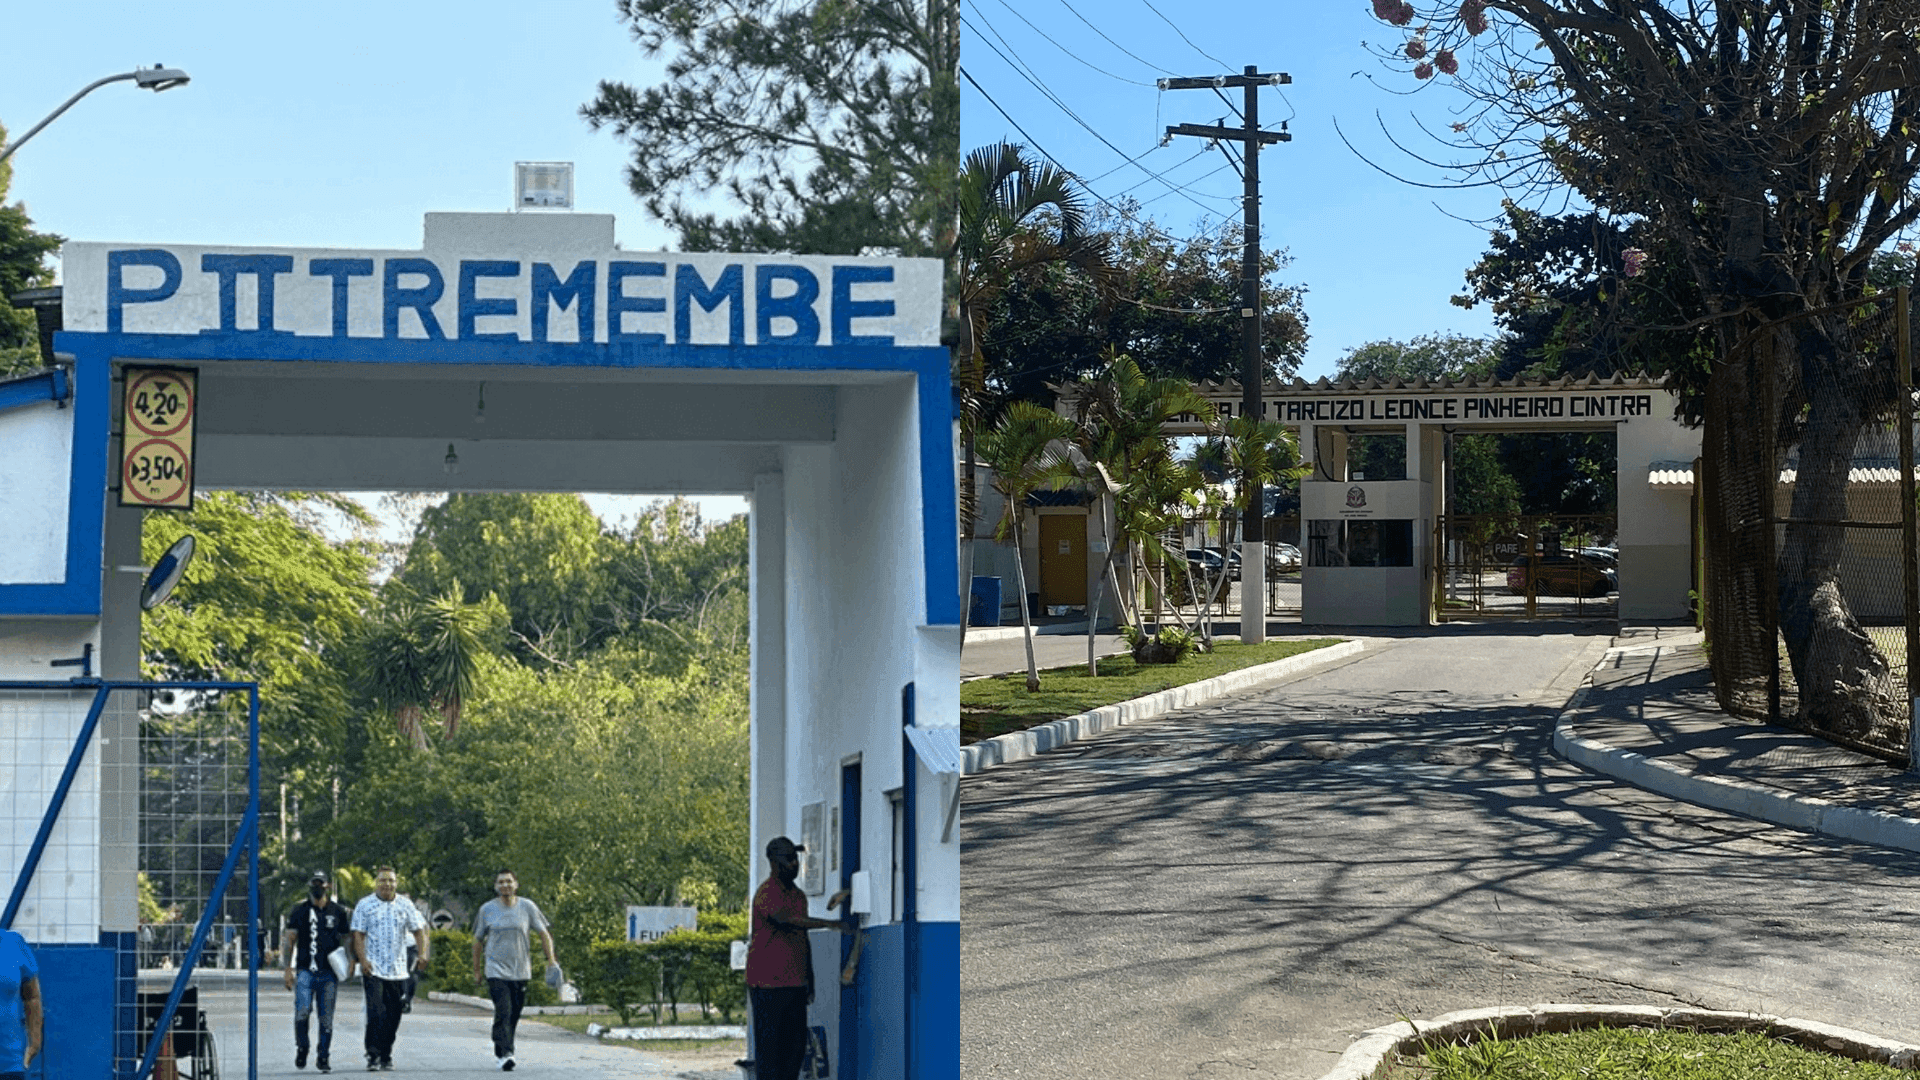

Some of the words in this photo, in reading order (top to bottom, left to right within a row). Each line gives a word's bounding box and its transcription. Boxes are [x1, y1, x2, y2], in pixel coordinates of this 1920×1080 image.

[308, 256, 896, 347] TREMEMBE
[1273, 399, 1364, 421] TARCIZO
[1370, 398, 1457, 419] LEONCE
[1463, 396, 1564, 418] PINHEIRO
[1570, 395, 1652, 417] CINTRA
[138, 455, 175, 486] 3,50
[1495, 543, 1518, 554] PARE
